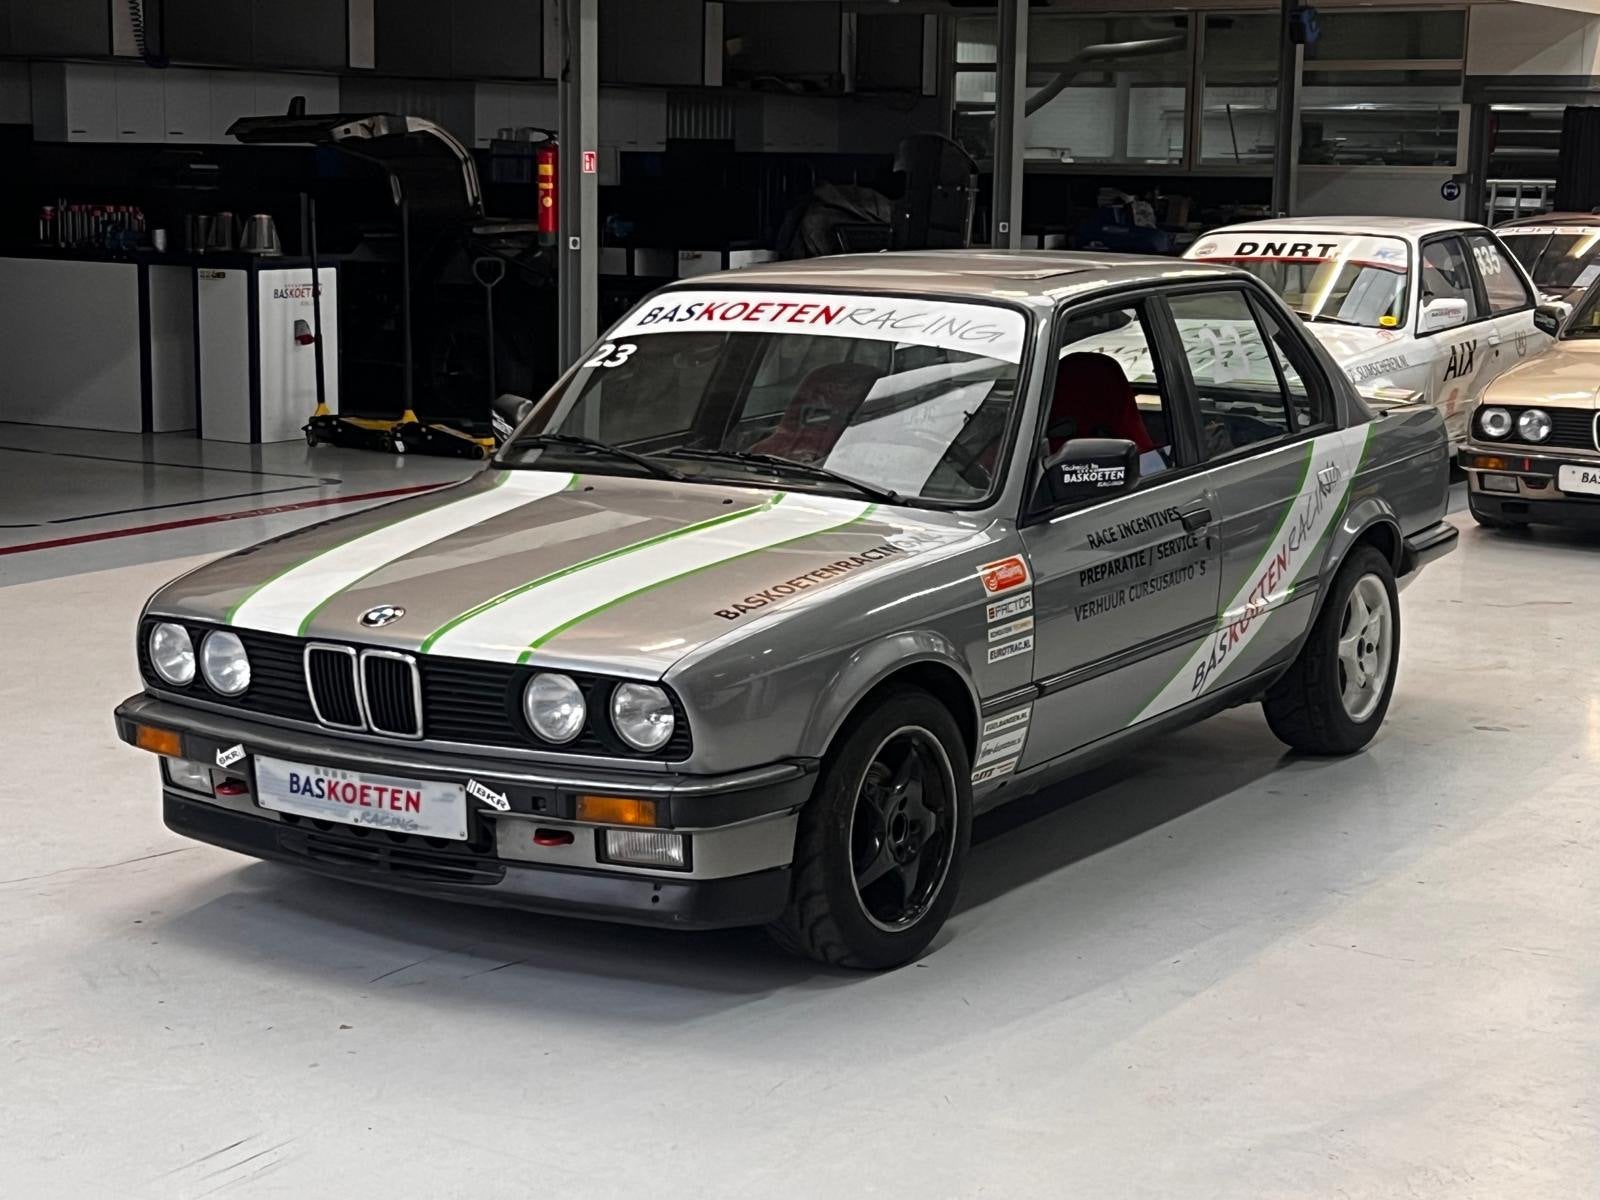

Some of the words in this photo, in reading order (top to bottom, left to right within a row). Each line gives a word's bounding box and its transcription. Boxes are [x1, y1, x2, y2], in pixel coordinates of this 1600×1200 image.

[583, 344, 637, 368] 23
[1064, 470, 1125, 484] BASKOETEN
[1087, 527, 1118, 550] RACE
[1116, 506, 1181, 540] INCENTIVES
[1080, 548, 1147, 588] PREPARATIE
[1157, 533, 1199, 560] SERVICE
[1074, 589, 1126, 622] VERHUUR
[289, 772, 422, 813] BASKOETEN
[476, 787, 508, 808] BKR
